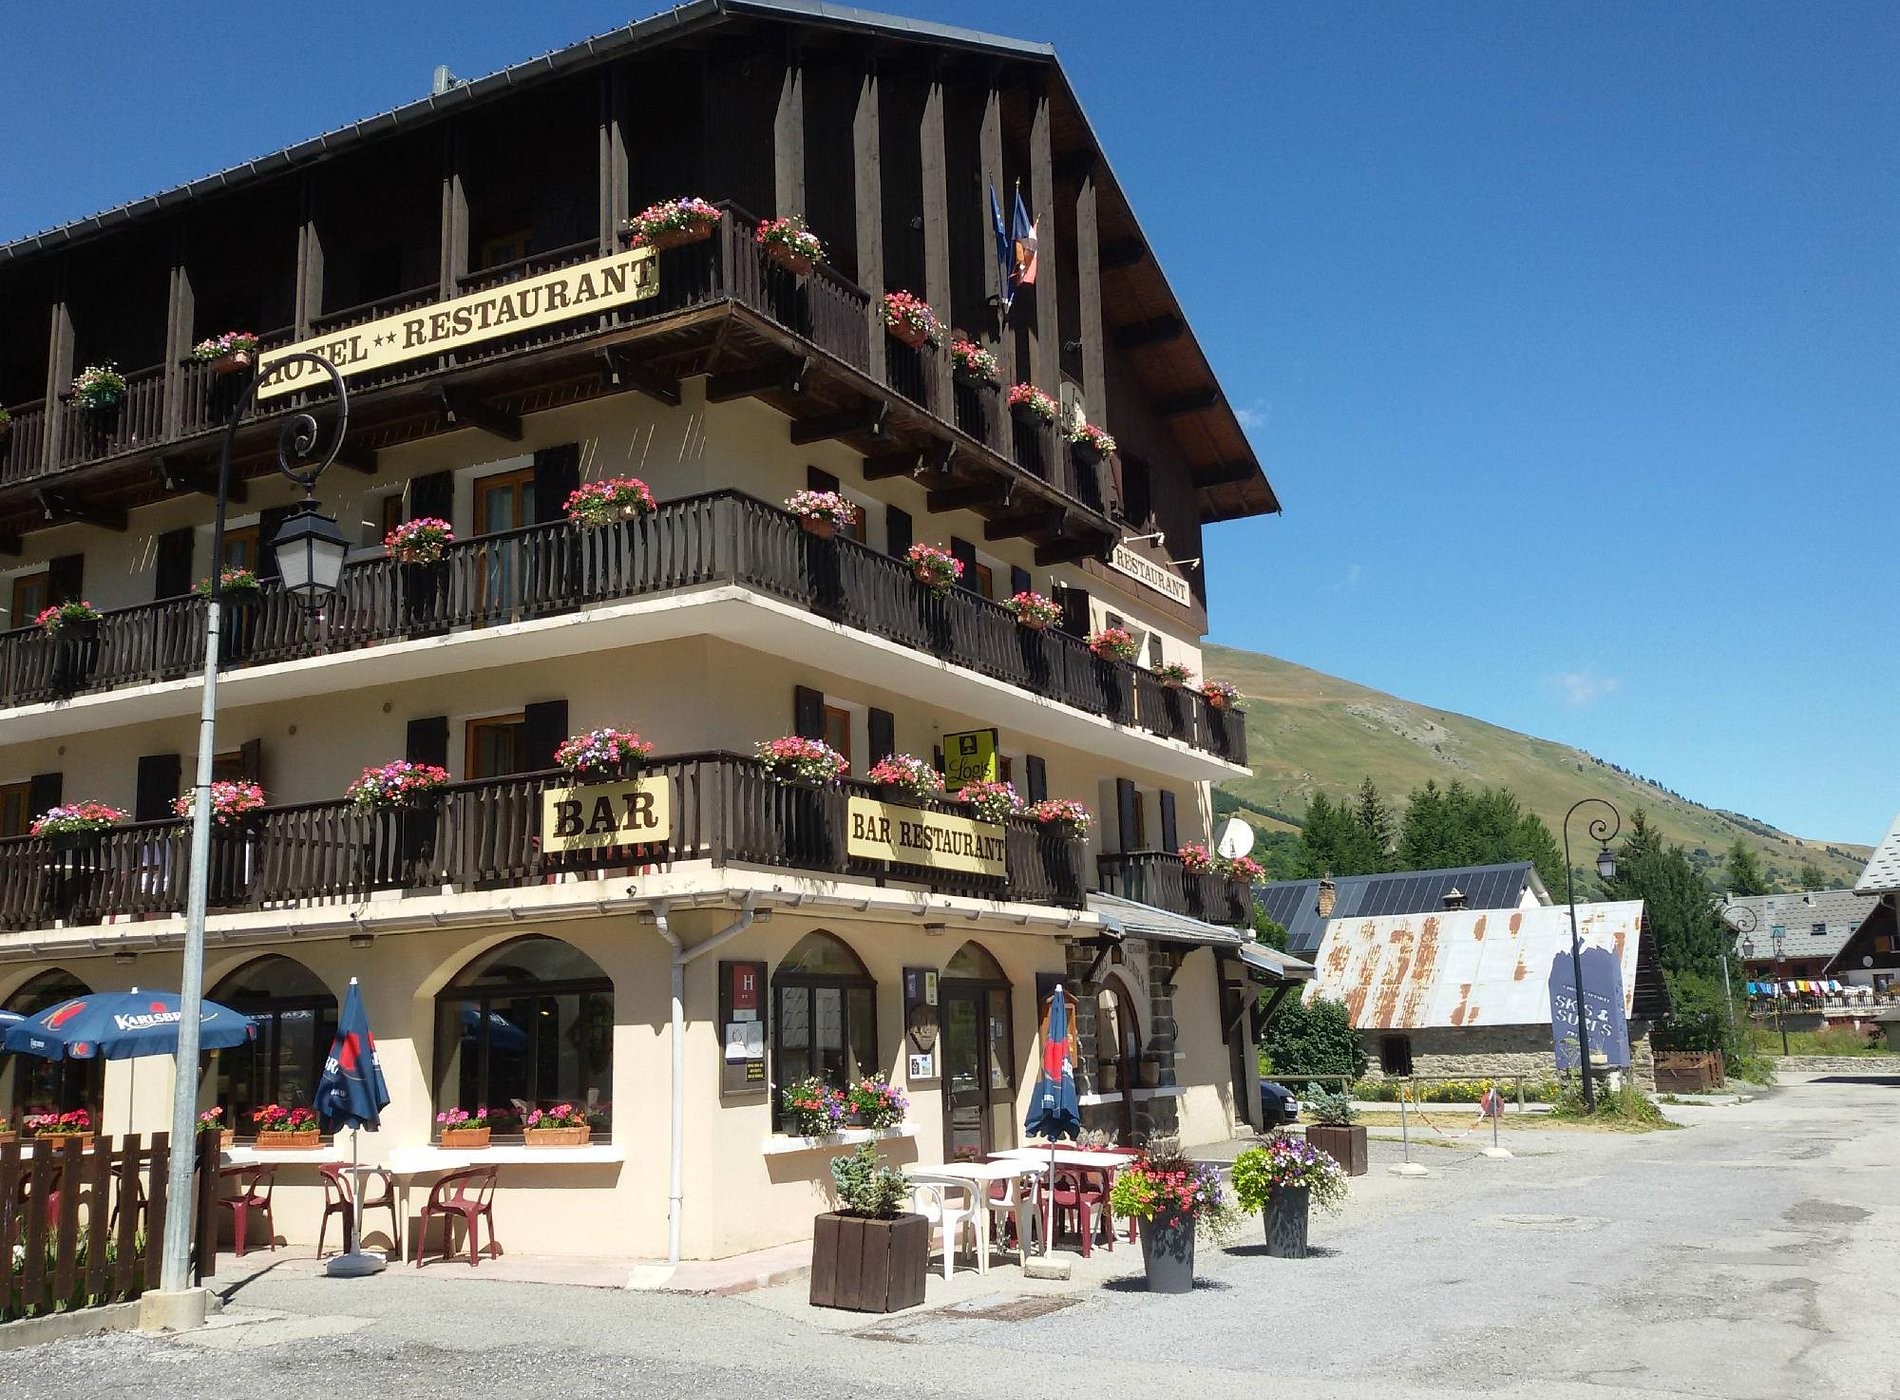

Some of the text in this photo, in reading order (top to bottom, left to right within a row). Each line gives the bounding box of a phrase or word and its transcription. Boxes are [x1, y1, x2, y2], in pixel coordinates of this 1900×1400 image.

[261, 256, 656, 388] HOTEL RESTAURANT
[1116, 547, 1186, 600] RESTAURANT
[948, 756, 992, 783] Logis
[553, 791, 659, 839] BAR
[852, 812, 1005, 862] BAR RESTAURANT
[743, 974, 754, 991] H
[113, 1010, 202, 1031] KARLSBR
[1555, 995, 1593, 1016] SKS
